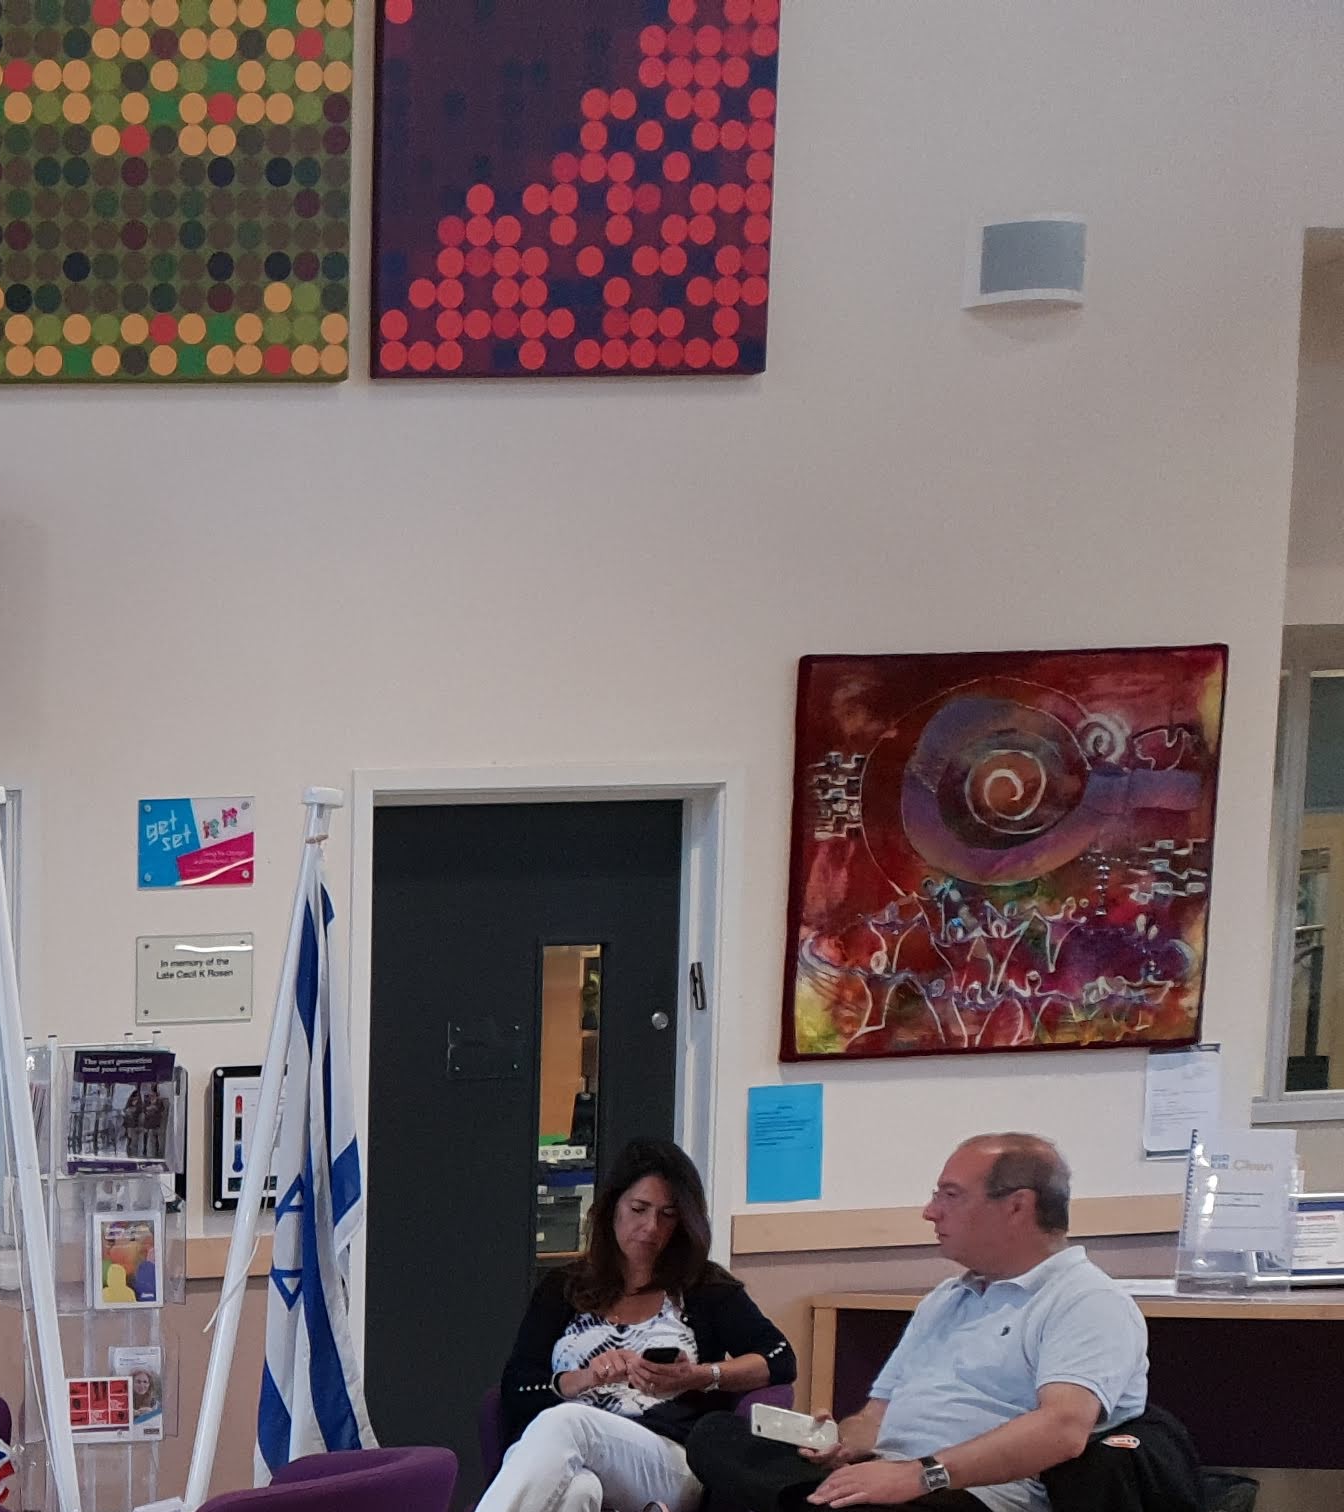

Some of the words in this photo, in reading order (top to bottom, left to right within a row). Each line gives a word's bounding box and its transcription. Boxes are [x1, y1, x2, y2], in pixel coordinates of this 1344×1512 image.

[146, 810, 178, 846] get
[161, 824, 192, 852] set
[160, 960, 169, 968] In
[170, 960, 204, 968] memory
[205, 957, 215, 966] of
[217, 958, 230, 966] the
[156, 971, 175, 980] Late
